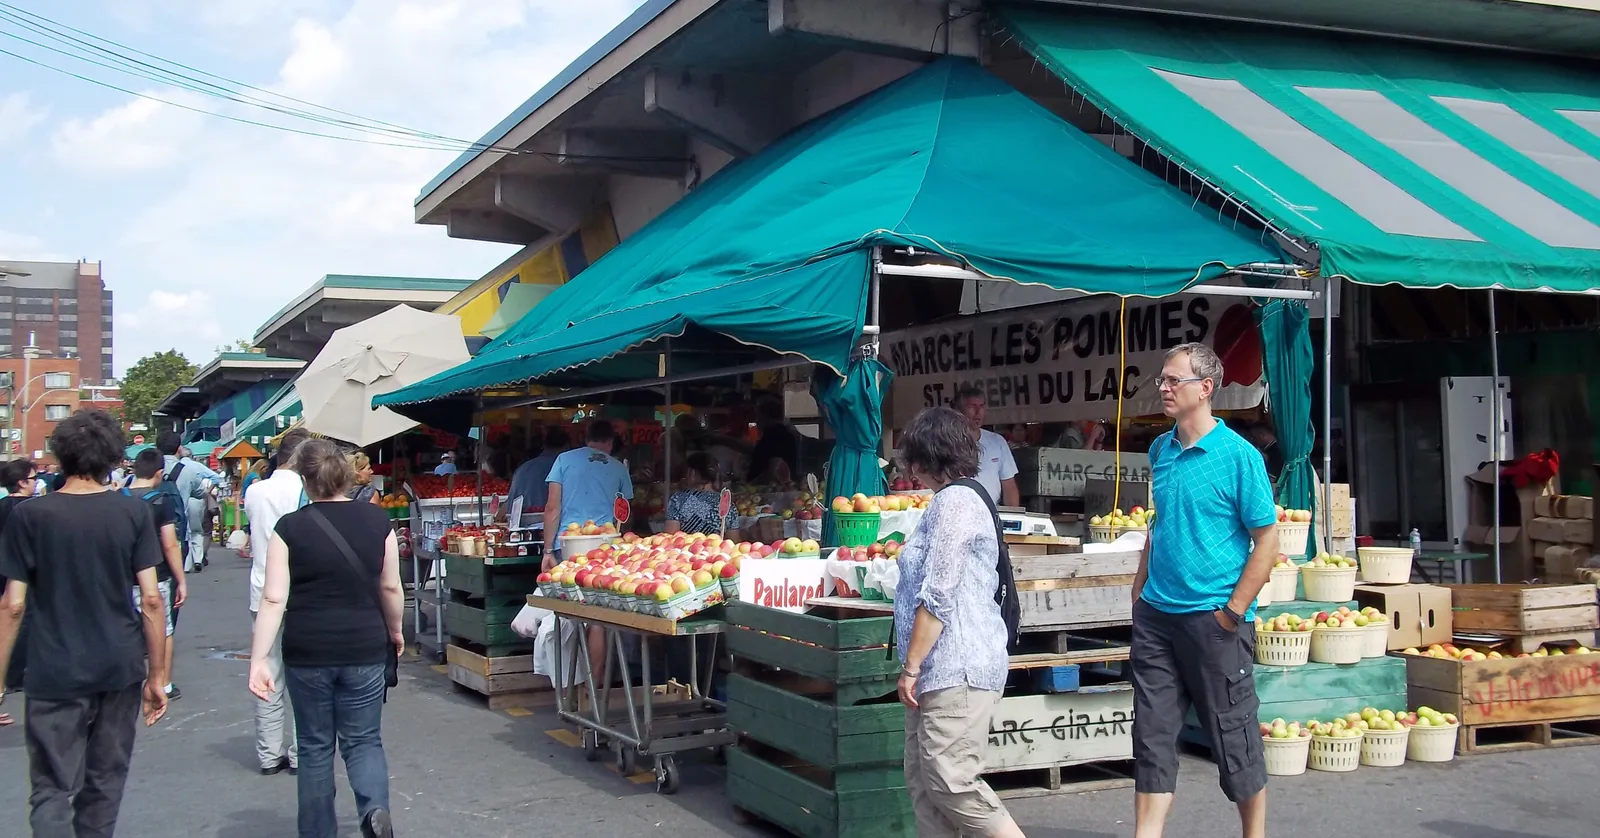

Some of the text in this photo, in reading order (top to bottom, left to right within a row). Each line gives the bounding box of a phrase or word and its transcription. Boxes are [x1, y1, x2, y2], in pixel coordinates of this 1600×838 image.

[890, 296, 1210, 377] MARCEL LES POMMES
[1038, 370, 1074, 405] DU
[1084, 365, 1141, 402] LAC
[1046, 461, 1152, 482] MARC-GIRAR
[753, 576, 825, 608] Paulared
[987, 708, 1135, 747] ARC-GIRAR
